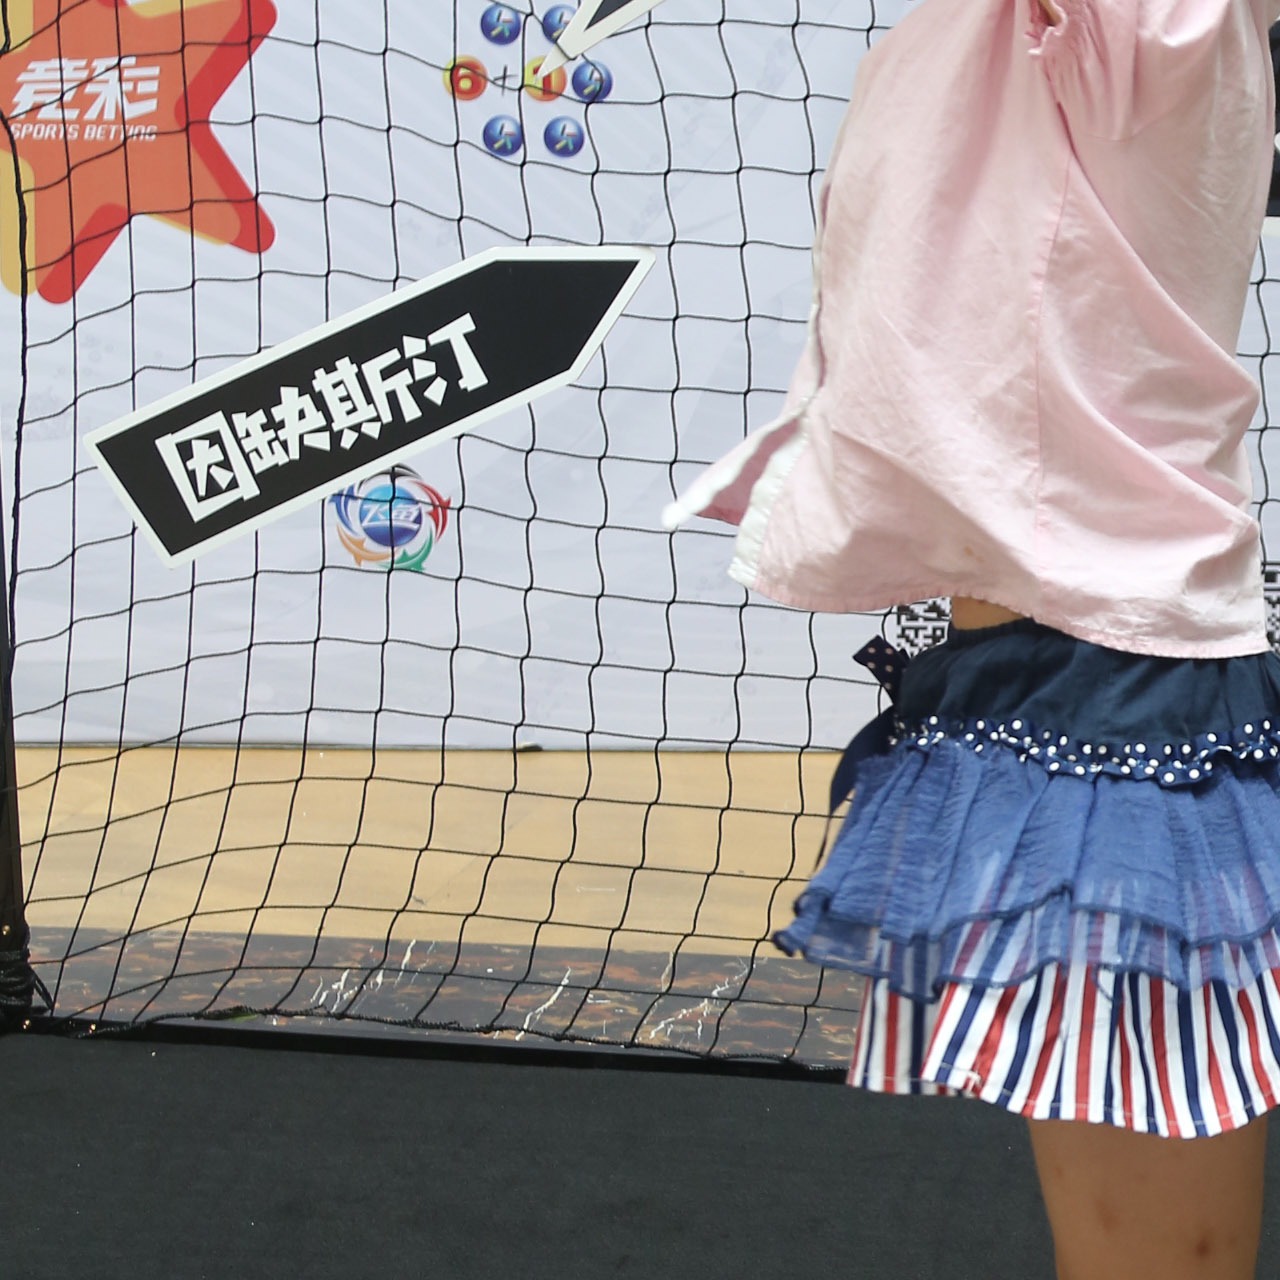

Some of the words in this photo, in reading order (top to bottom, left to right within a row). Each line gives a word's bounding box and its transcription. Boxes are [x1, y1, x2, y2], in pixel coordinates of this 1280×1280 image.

[10, 56, 161, 121] 竞彩
[10, 122, 79, 140] SPORTS
[83, 123, 158, 142] BETTING
[155, 312, 489, 523] 因缺斯汀
